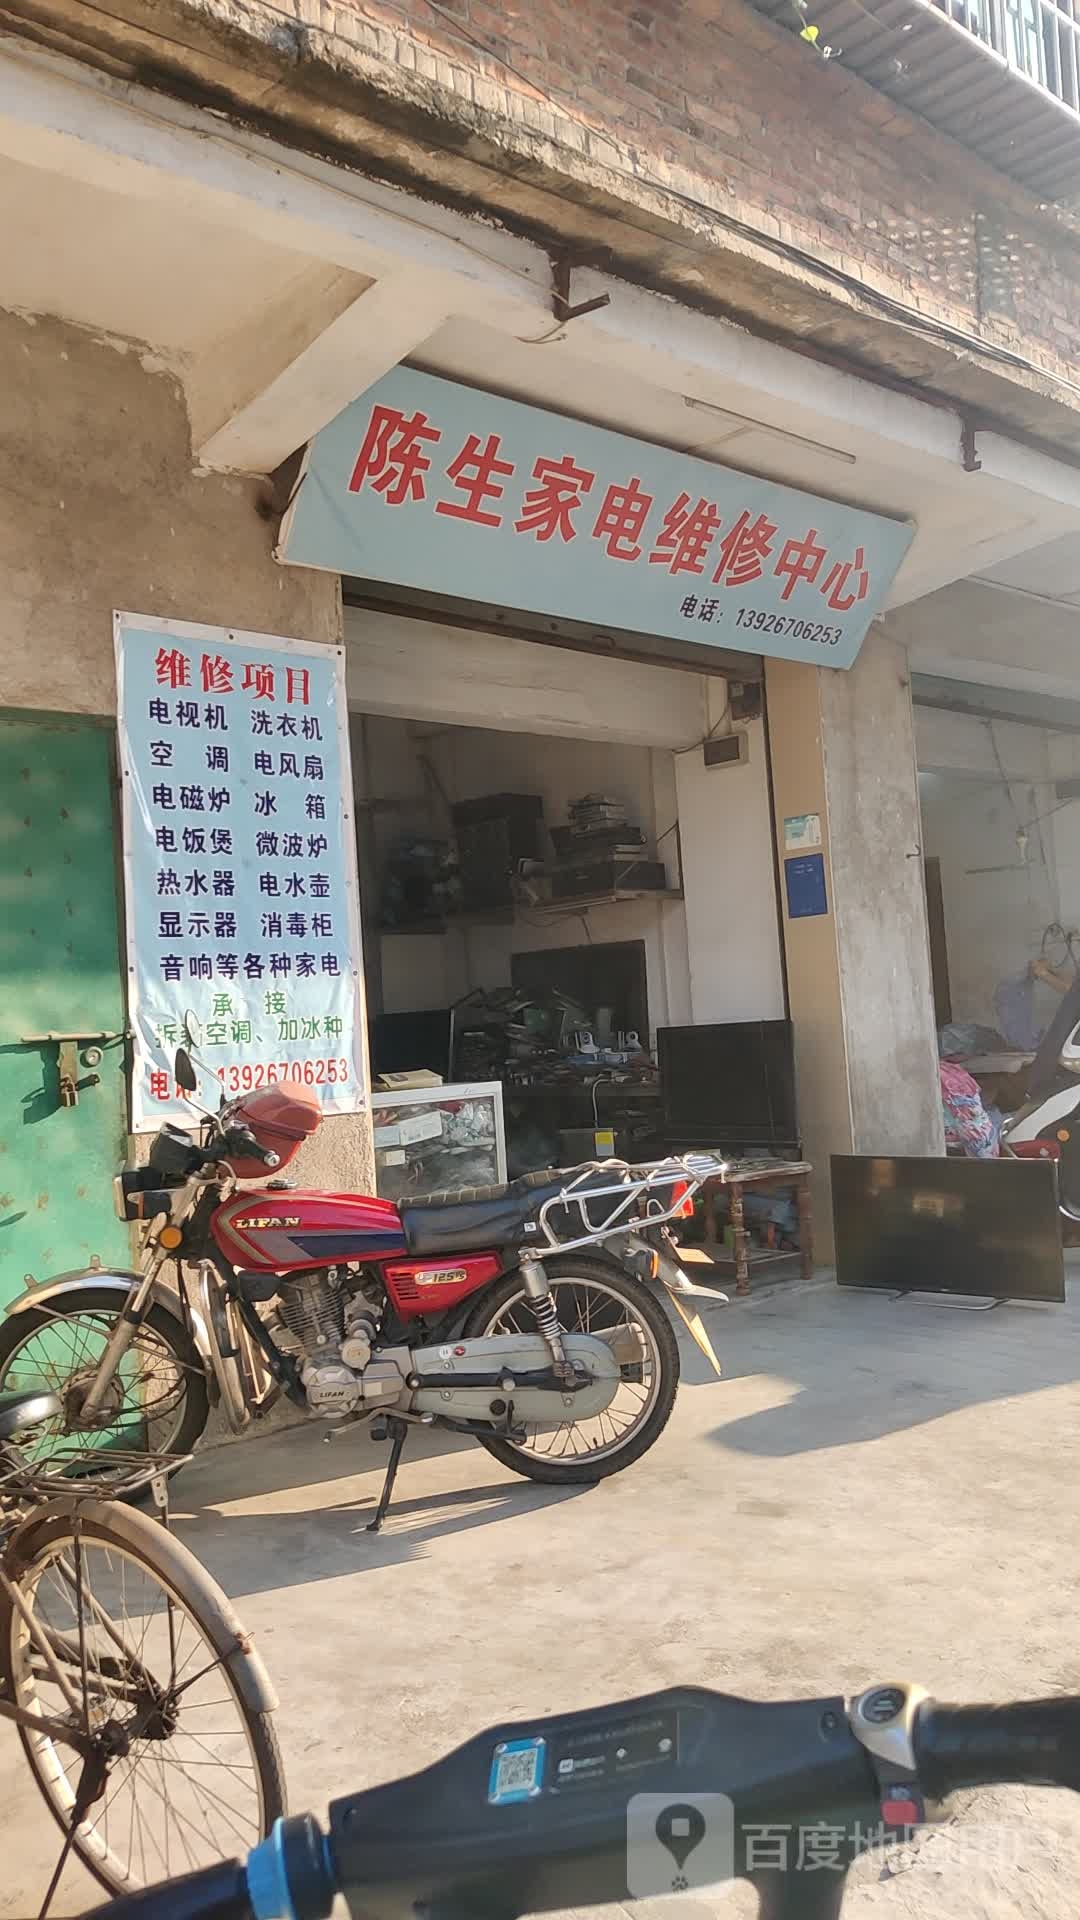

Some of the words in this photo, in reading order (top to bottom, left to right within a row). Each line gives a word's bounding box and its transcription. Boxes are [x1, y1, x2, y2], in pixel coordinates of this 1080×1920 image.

[348, 403, 872, 614] 陈生家电维修中心
[735, 608, 842, 646] 13926706253
[154, 647, 311, 705] 维修项目
[149, 697, 228, 731] 电视机
[250, 710, 324, 741] 洗衣机
[150, 740, 229, 773] 空调
[253, 749, 324, 781] 电风扇
[152, 783, 231, 813] 电磁炉
[254, 791, 326, 820] 冰箱
[155, 826, 233, 856] 电饭煲
[256, 831, 328, 859] 微波炉
[156, 868, 235, 896] 热水器
[259, 872, 330, 898] 电水壶
[158, 912, 237, 939] 显示器
[260, 912, 334, 938] 消毒柜
[160, 952, 341, 981] 音响等各种家电
[212, 991, 287, 1017] 承接
[235, 1217, 301, 1229] LIFAN
